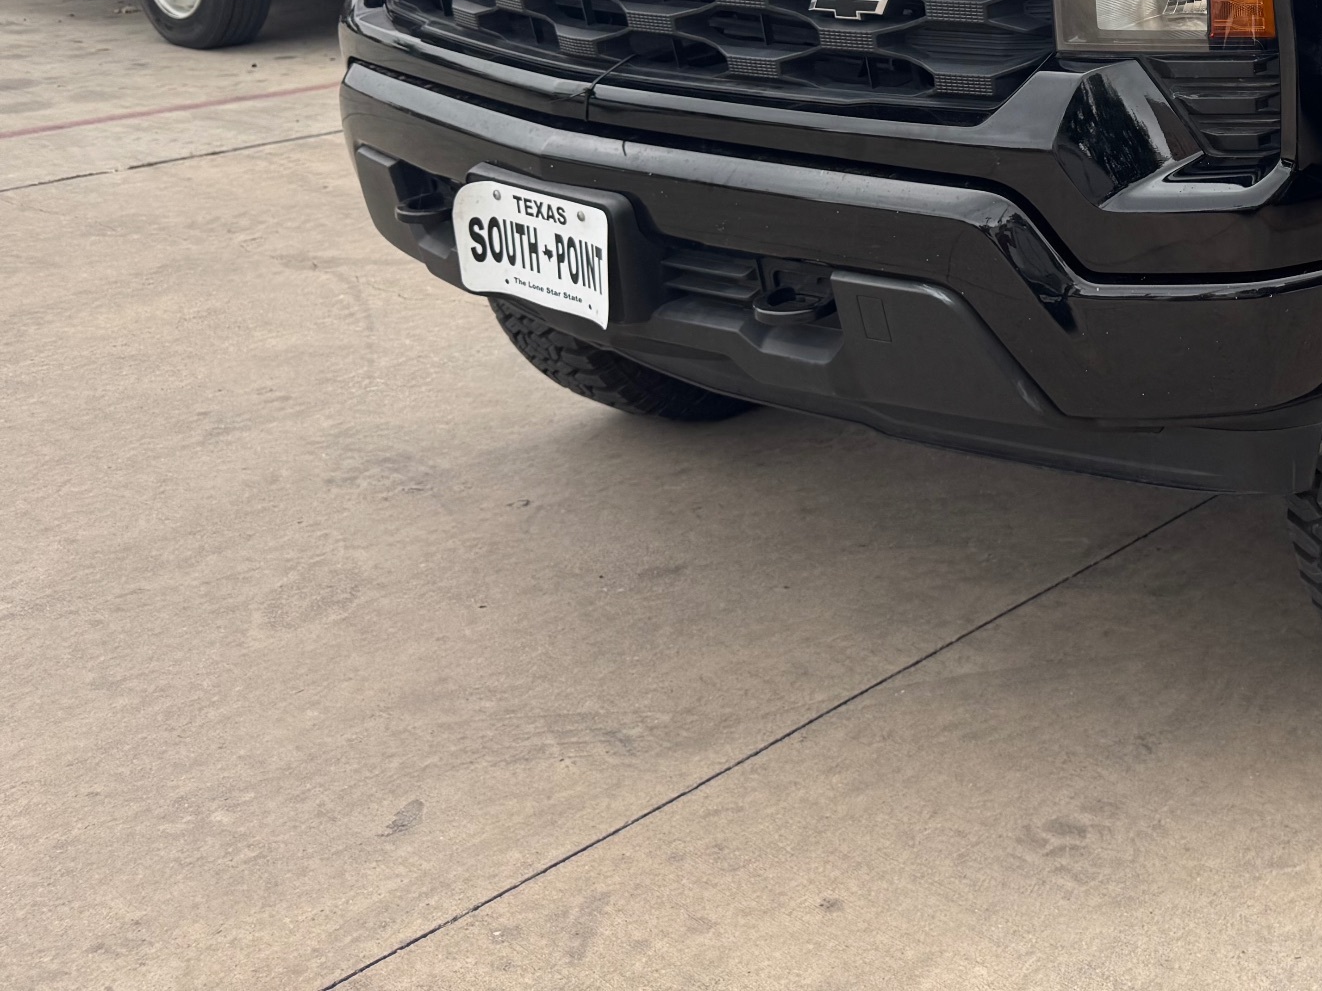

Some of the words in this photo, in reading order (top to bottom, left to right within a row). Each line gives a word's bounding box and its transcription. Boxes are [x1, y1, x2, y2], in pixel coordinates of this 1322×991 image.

[512, 195, 567, 225] TEXAS
[468, 216, 540, 274] SOUTH
[554, 233, 603, 295] POINT
[514, 276, 527, 287] The
[528, 281, 544, 293] Lone
[546, 287, 561, 297] Star
[563, 291, 583, 304] State
